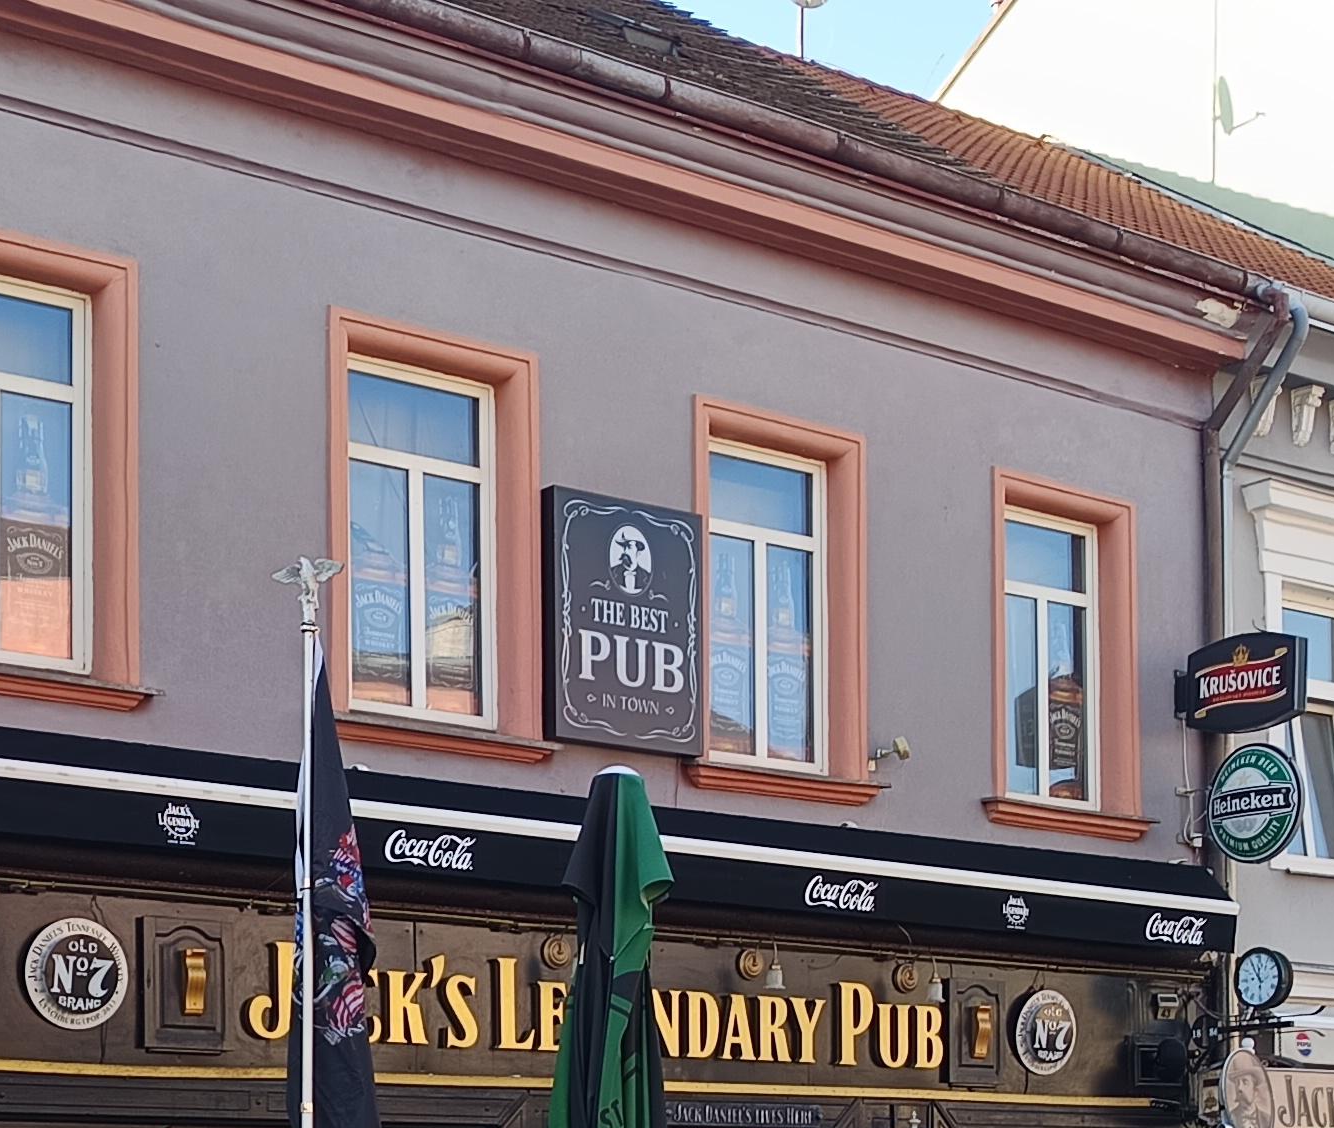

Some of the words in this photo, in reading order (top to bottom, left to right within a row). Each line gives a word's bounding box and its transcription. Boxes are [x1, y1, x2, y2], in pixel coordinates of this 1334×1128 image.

[590, 597, 626, 627] THE
[630, 604, 668, 634] BEST
[578, 628, 684, 694] PUB
[1199, 665, 1281, 700] KRUŠOVICE
[602, 693, 616, 709] IN
[620, 696, 660, 715] TOWN
[1220, 755, 1255, 782] HEINEKEN
[1257, 754, 1279, 776] BEER
[1213, 789, 1285, 816] Heineken
[384, 829, 476, 871] Coca-Cola
[1218, 829, 1249, 851] PREMIUM
[1251, 820, 1281, 849] QUALITY
[804, 875, 879, 912] Coca-Cola
[1146, 912, 1207, 945] Coca-Cola
[68, 939, 98, 954] OLD
[58, 995, 102, 1011] BRAND
[249, 941, 479, 1048] JK'S
[496, 957, 827, 1064] LENDARY
[835, 981, 945, 1069] PUB
[673, 1103, 702, 1122] JACK
[705, 1104, 752, 1123] DANIEL'S
[755, 1109, 784, 1124] LIVES
